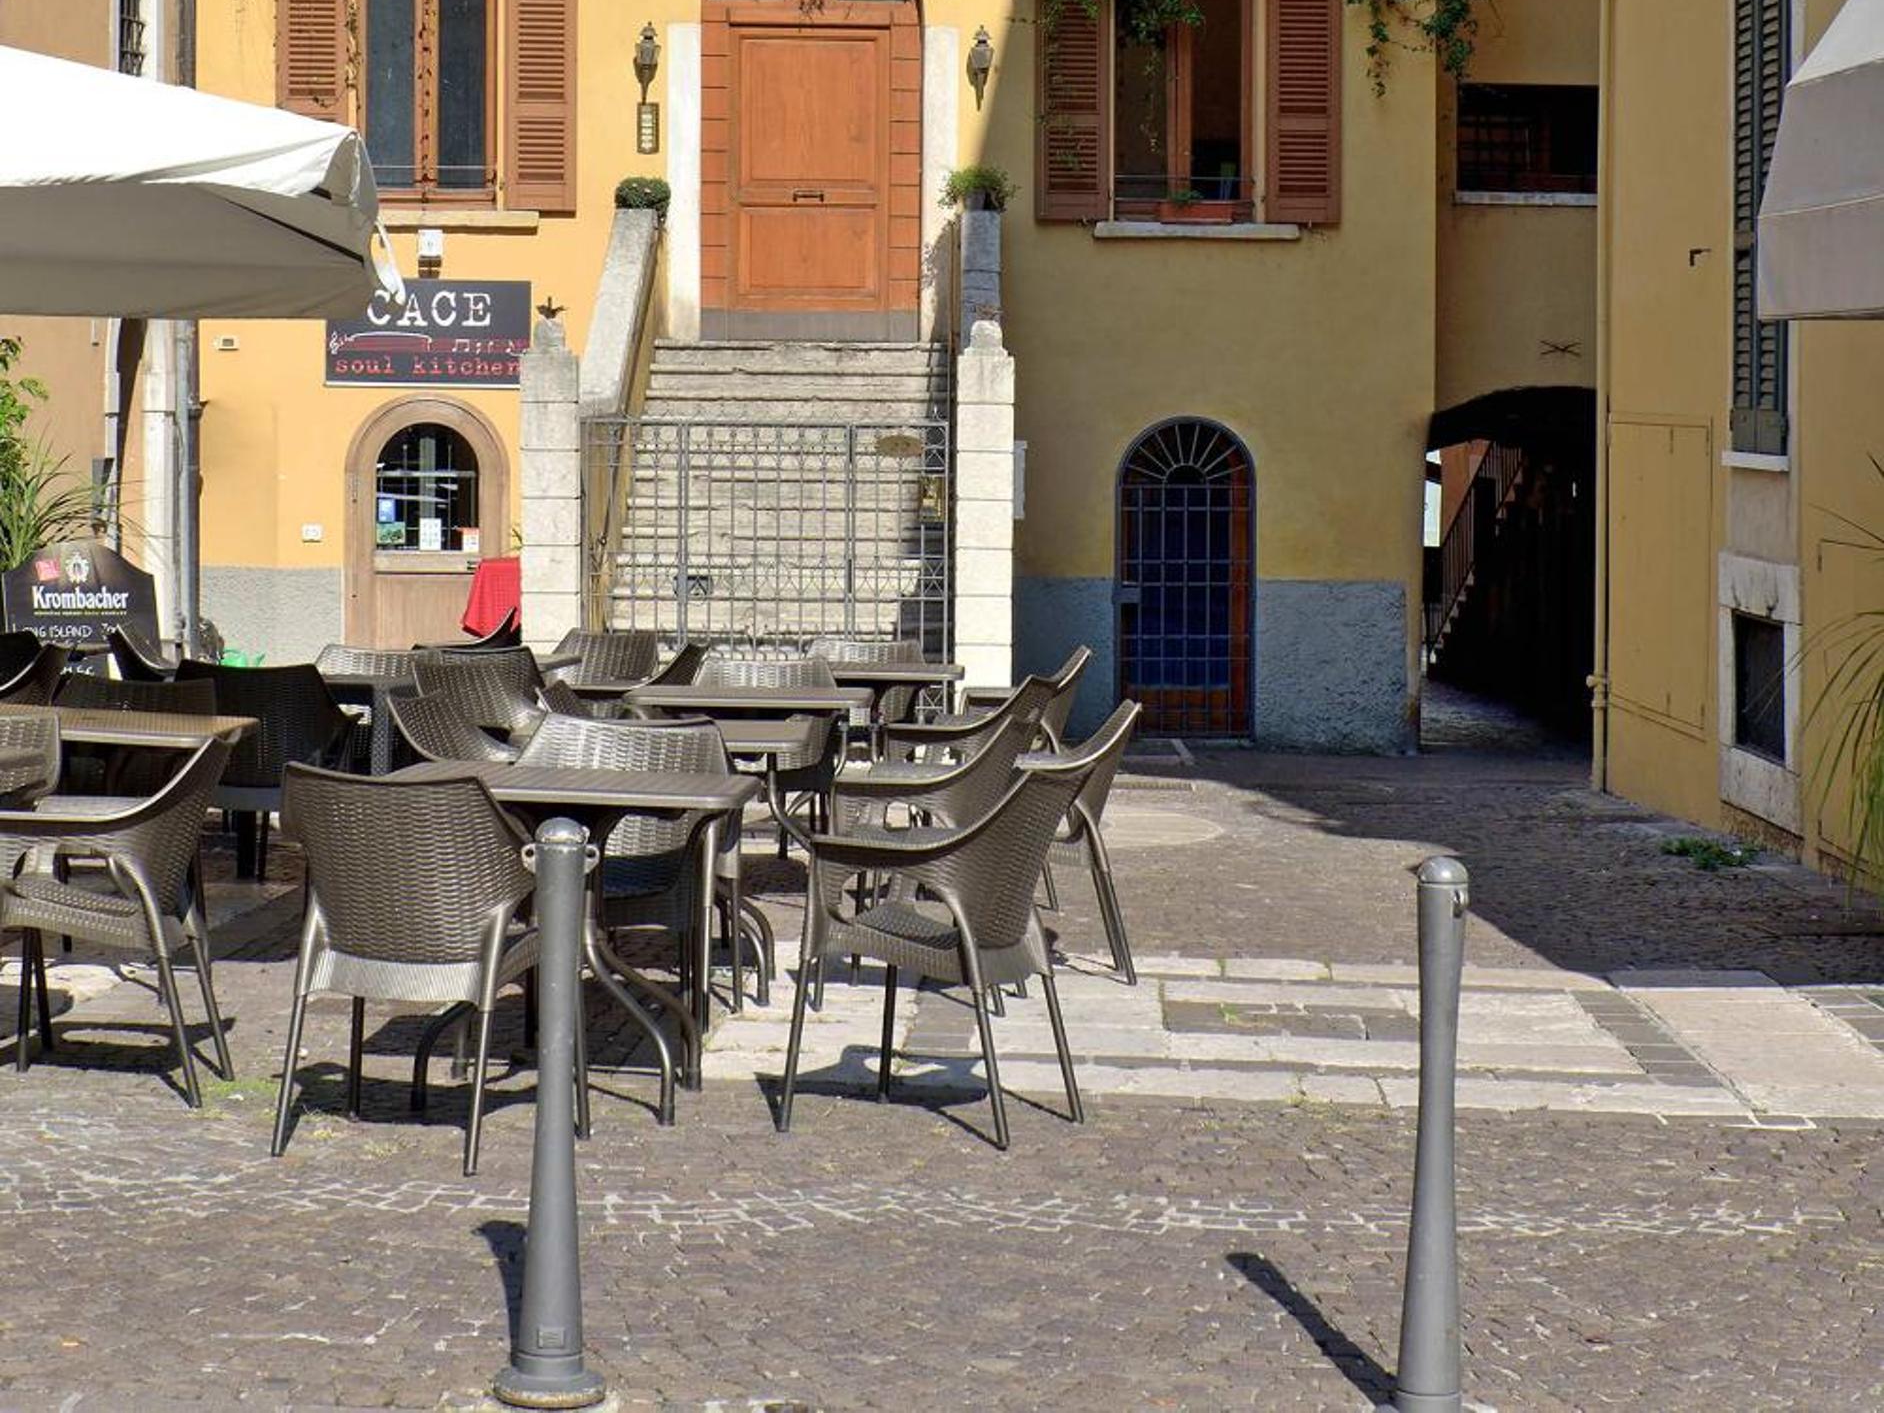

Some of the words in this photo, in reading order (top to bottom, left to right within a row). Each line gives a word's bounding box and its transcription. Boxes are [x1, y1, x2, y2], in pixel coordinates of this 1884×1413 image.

[366, 289, 491, 327] CACE
[335, 355, 395, 375] soul
[31, 585, 129, 609] Krombacher
[49, 624, 93, 638] ISLAND
